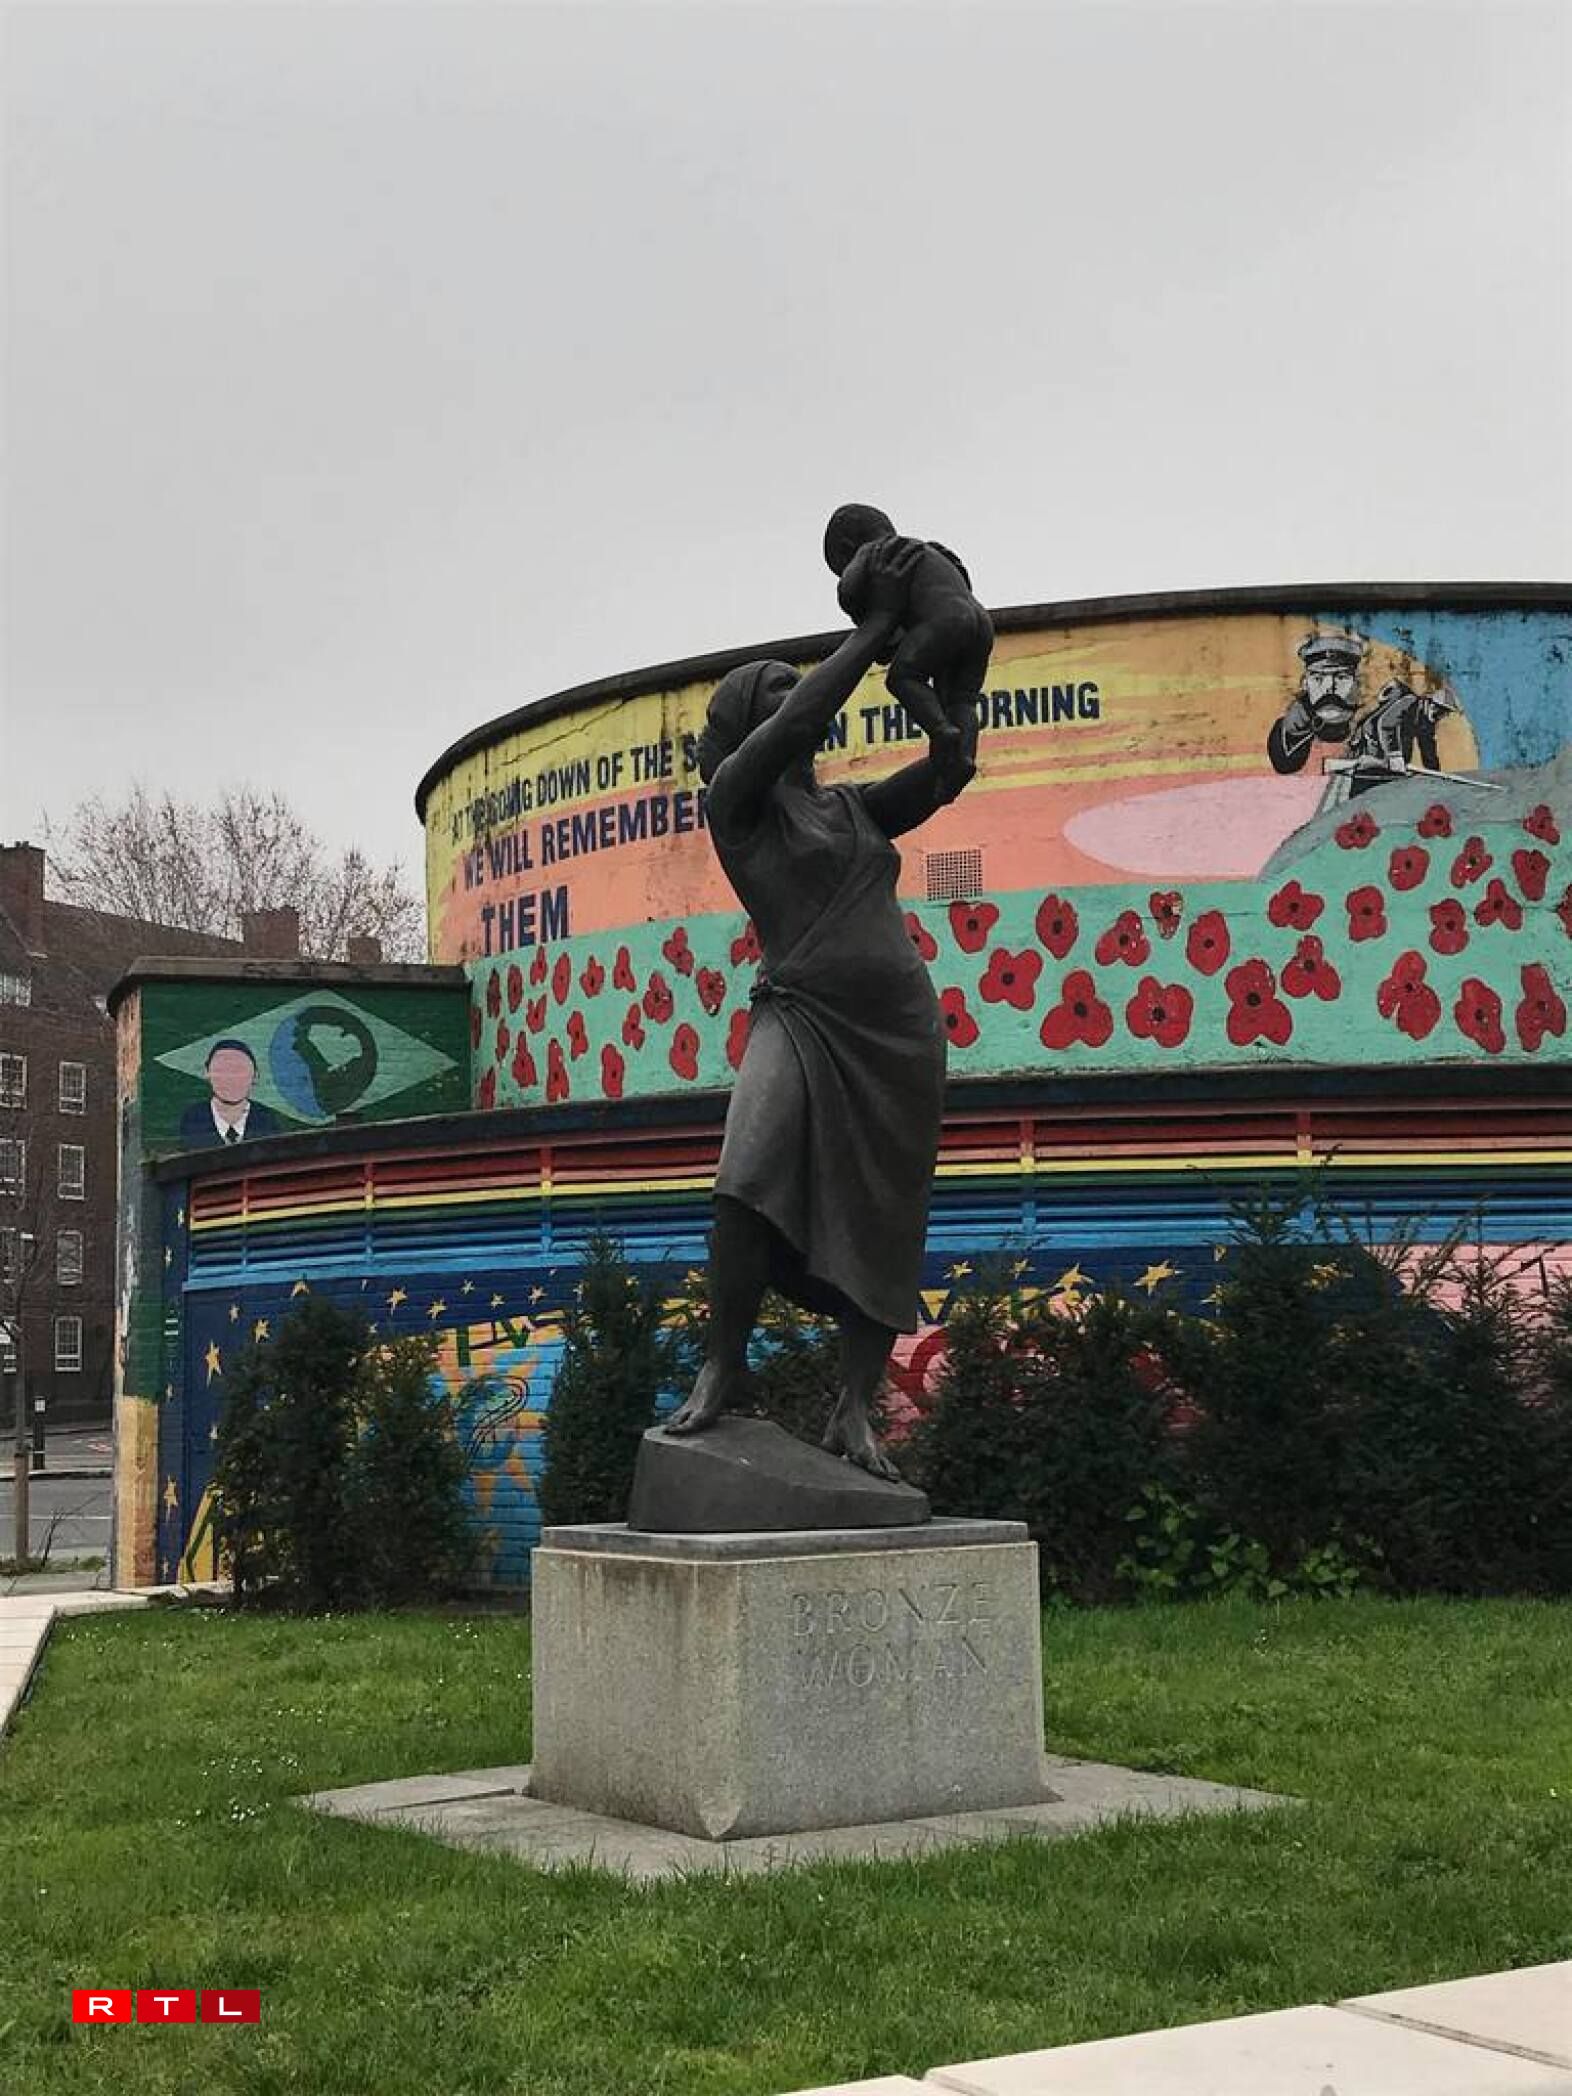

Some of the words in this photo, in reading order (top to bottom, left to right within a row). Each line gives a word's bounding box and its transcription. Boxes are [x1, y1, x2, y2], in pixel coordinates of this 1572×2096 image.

[537, 759, 590, 807] DOWN
[598, 751, 623, 789] OF
[630, 740, 672, 783] THE
[976, 682, 1100, 729] ORNING
[464, 847, 484, 891] WE
[490, 829, 533, 880] WILL
[481, 885, 570, 957] THEM
[790, 1582, 992, 1637] BRONZE
[797, 1632, 989, 1690] WOMAN
